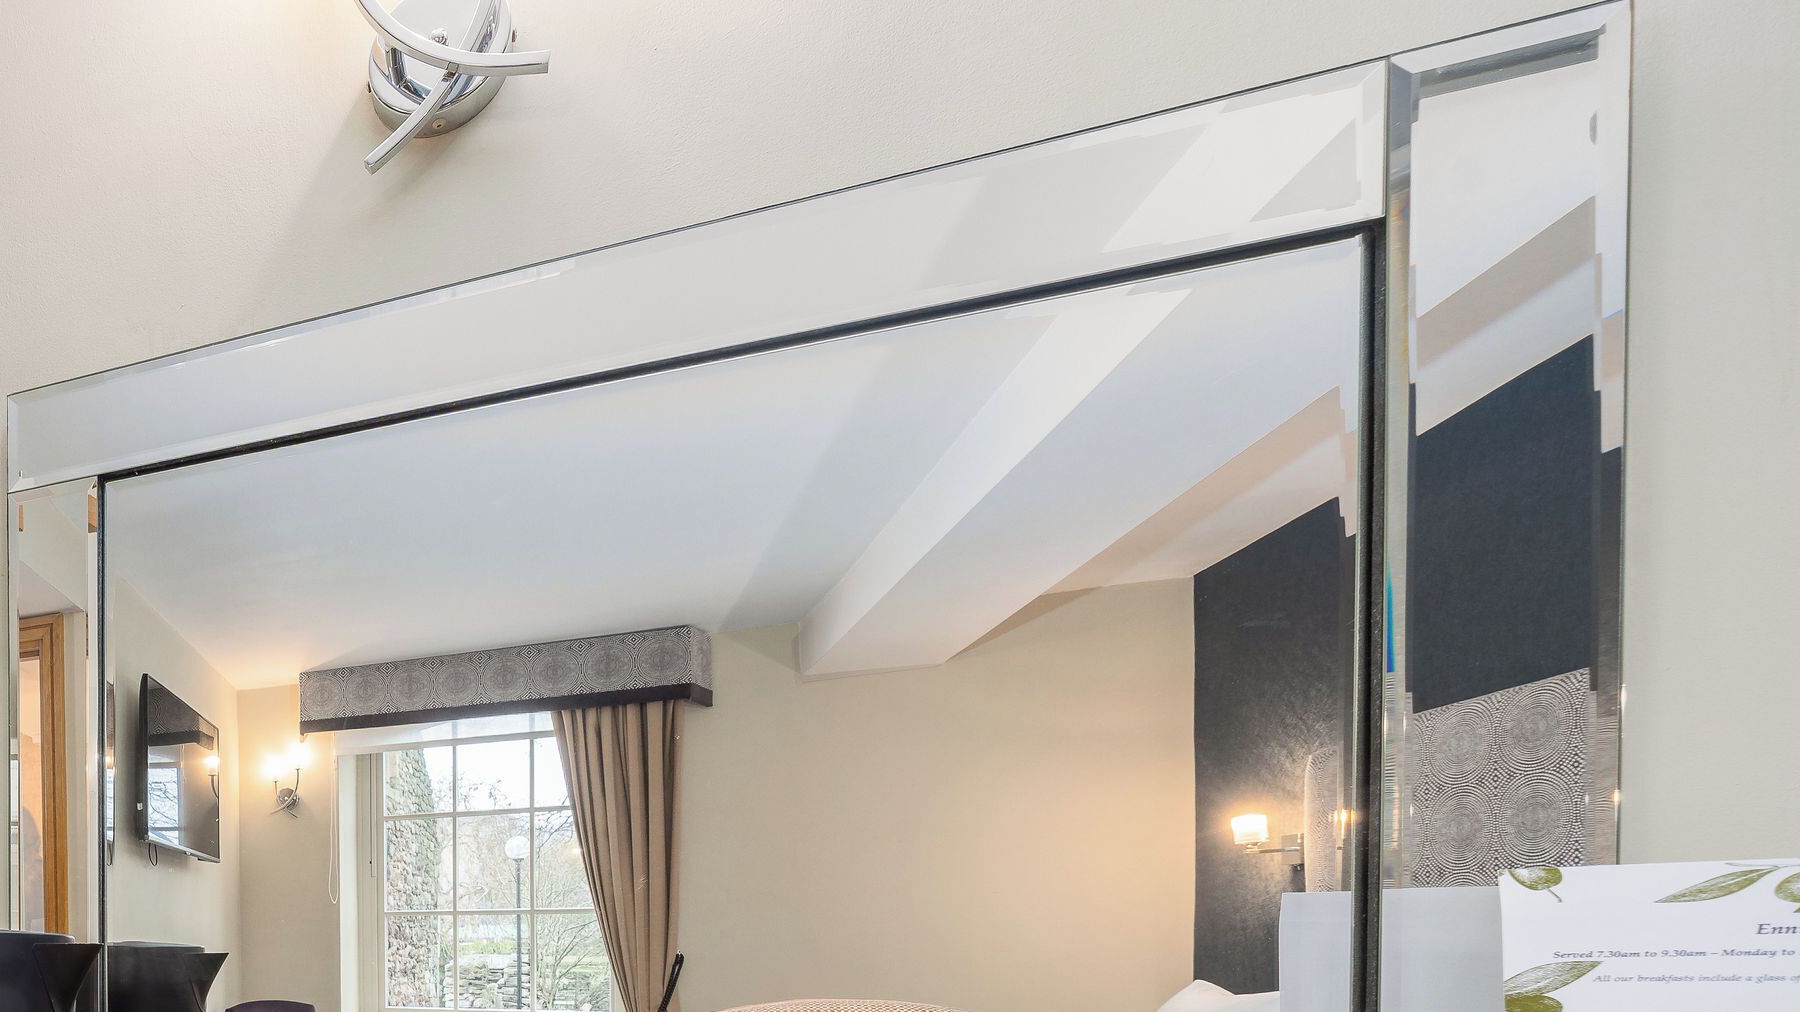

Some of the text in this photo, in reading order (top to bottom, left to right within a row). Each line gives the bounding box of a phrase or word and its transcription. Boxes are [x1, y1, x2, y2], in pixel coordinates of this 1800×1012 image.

[1757, 923, 1800, 935] Enn
[1553, 950, 1593, 959] Served
[1644, 950, 1657, 958] to
[1721, 948, 1777, 958] Monday
